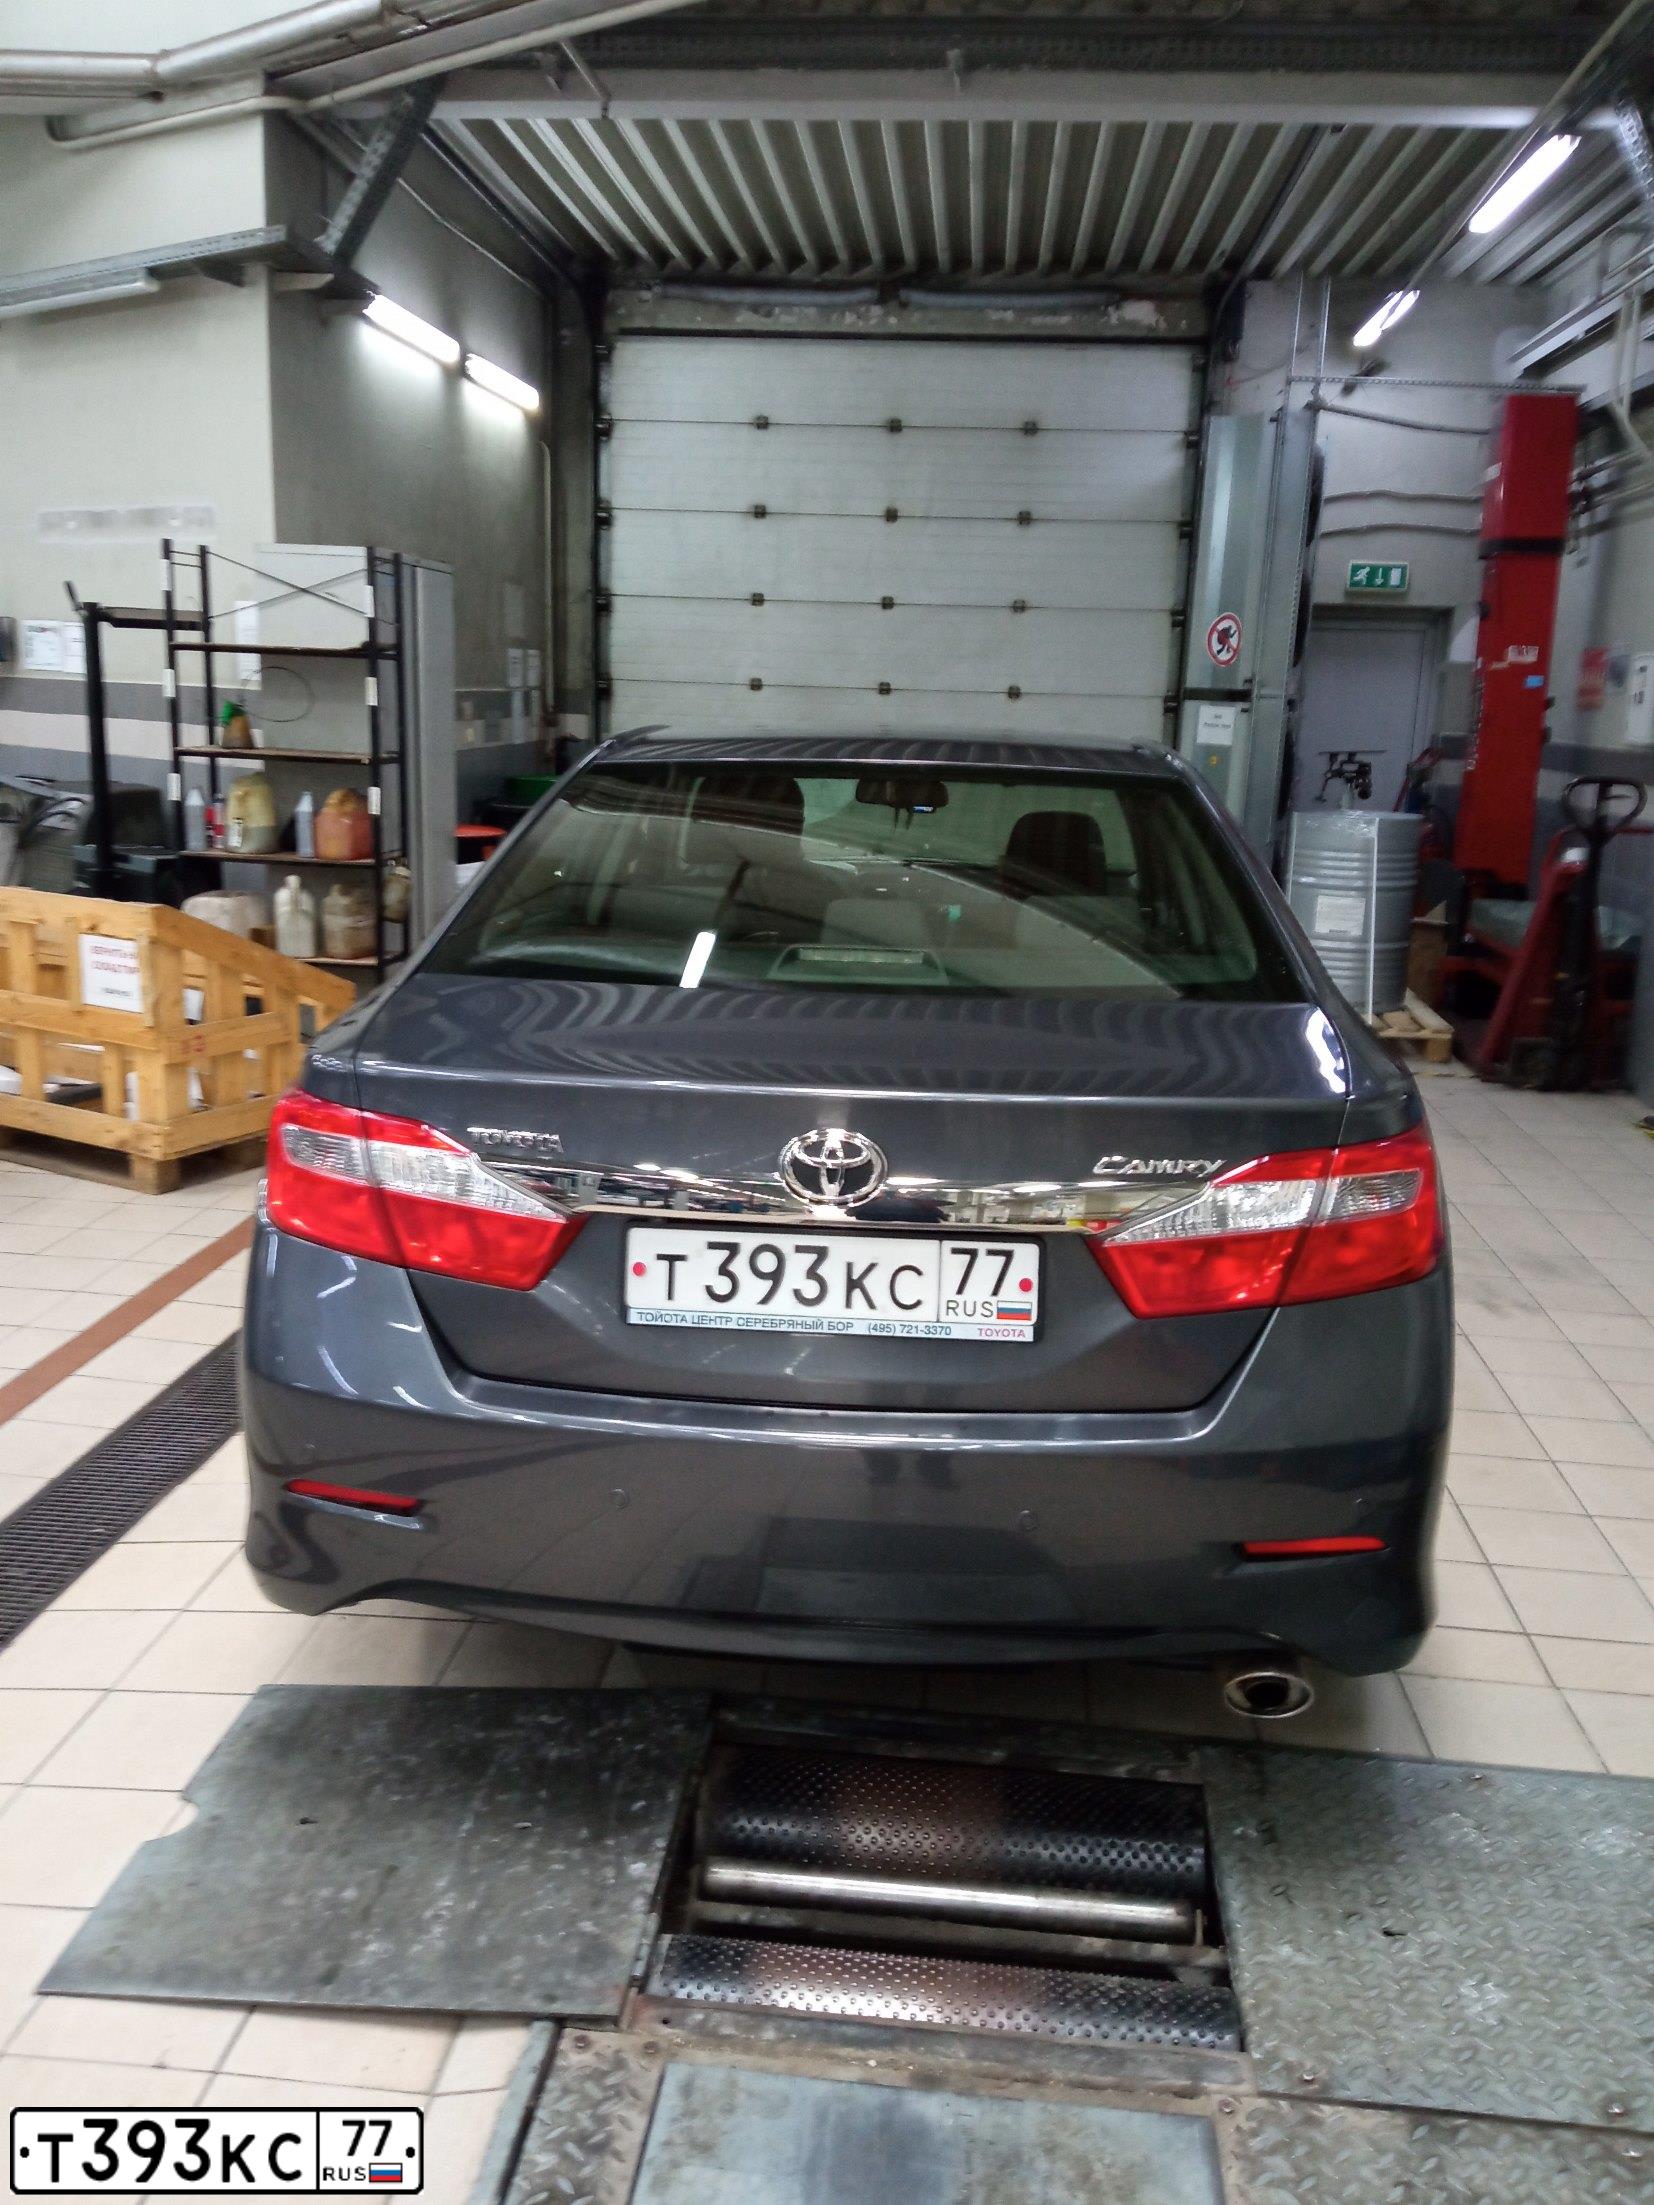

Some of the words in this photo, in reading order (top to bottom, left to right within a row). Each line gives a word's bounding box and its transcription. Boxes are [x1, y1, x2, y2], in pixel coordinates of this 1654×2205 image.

[949, 1247, 1015, 1297] 77
[945, 1299, 995, 1319] RUS
[636, 1309, 688, 1324] ТОЙОТА
[691, 1314, 733, 1326] ЦЕНТР
[736, 1316, 824, 1331] СЕРЕБРЯНЫЙ
[827, 1320, 854, 1332] БОР
[868, 1323, 896, 1335] (495)
[900, 1323, 952, 1336] 721-3370
[977, 1327, 1026, 1338] TOYOTA
